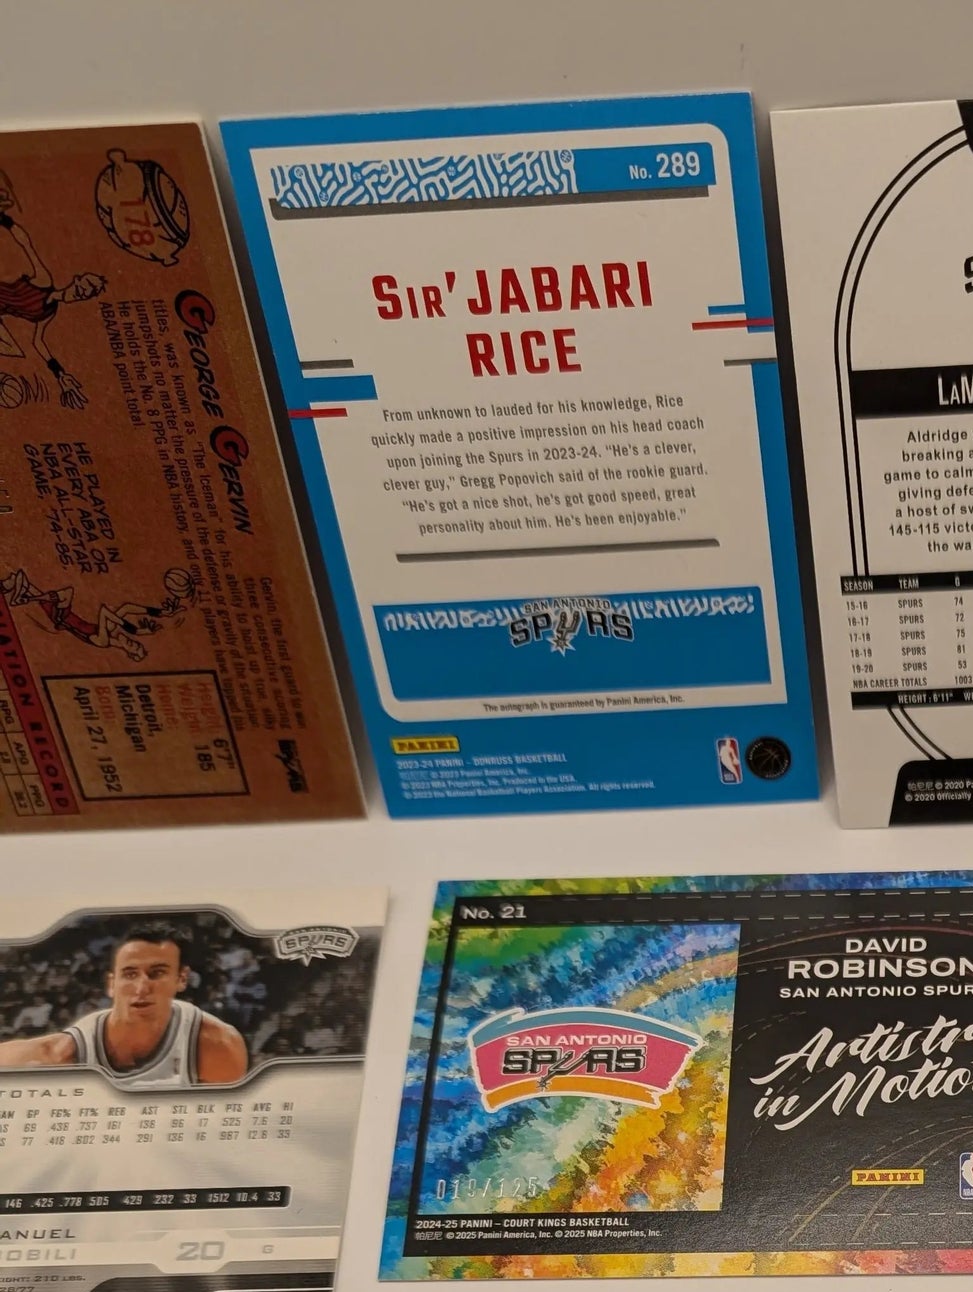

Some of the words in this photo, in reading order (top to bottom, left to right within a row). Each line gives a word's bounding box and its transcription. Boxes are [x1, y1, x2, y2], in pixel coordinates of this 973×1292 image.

[629, 164, 652, 179] No.
[656, 151, 700, 178] 289
[123, 197, 155, 247] 178
[466, 328, 582, 377] RICE
[382, 408, 413, 423] From
[417, 407, 472, 422] unknown
[475, 406, 487, 418] to
[491, 402, 533, 417] lauded
[537, 401, 554, 415] for
[558, 399, 577, 414] his
[581, 396, 652, 413] knowledge,
[655, 394, 683, 409] Rice
[907, 428, 968, 444] Aldridge
[24, 444, 51, 499] GAME,
[40, 444, 62, 479] NBA
[54, 486, 92, 573] ALL-STAR
[58, 443, 88, 501] EVERY
[78, 508, 99, 542] ABA
[90, 549, 108, 573] OR
[74, 442, 93, 465] HE
[84, 474, 114, 540] PLAYED
[106, 548, 122, 562] IN
[843, 580, 874, 592] SEASON
[899, 578, 920, 590] TEAM
[524, 602, 549, 614] SAN
[553, 597, 612, 611] ANTONIO
[509, 609, 635, 656] SPURS
[115, 685, 147, 752] Michigan
[134, 684, 164, 737] Detroit,
[74, 686, 99, 721] April
[87, 725, 107, 750] 27,
[98, 756, 123, 793] 1952
[396, 740, 456, 752] PANINI
[461, 905, 494, 920] No.
[499, 903, 527, 919] 21
[845, 937, 927, 954] DAVID
[779, 987, 820, 999] SAN
[826, 986, 917, 998] ANTONIO
[506, 1035, 553, 1046] SAN
[555, 1034, 647, 1045] ANTONIO
[501, 1045, 646, 1091] SPURS
[753, 1087, 801, 1119] in
[856, 1171, 920, 1183] PANINI
[416, 1220, 458, 1229] 2024-25
[460, 1219, 492, 1228] PANINI
[504, 1218, 535, 1228] COURT
[537, 1218, 566, 1227] KINGS
[569, 1217, 629, 1226] BASKETBALL
[175, 1241, 226, 1261] 20
